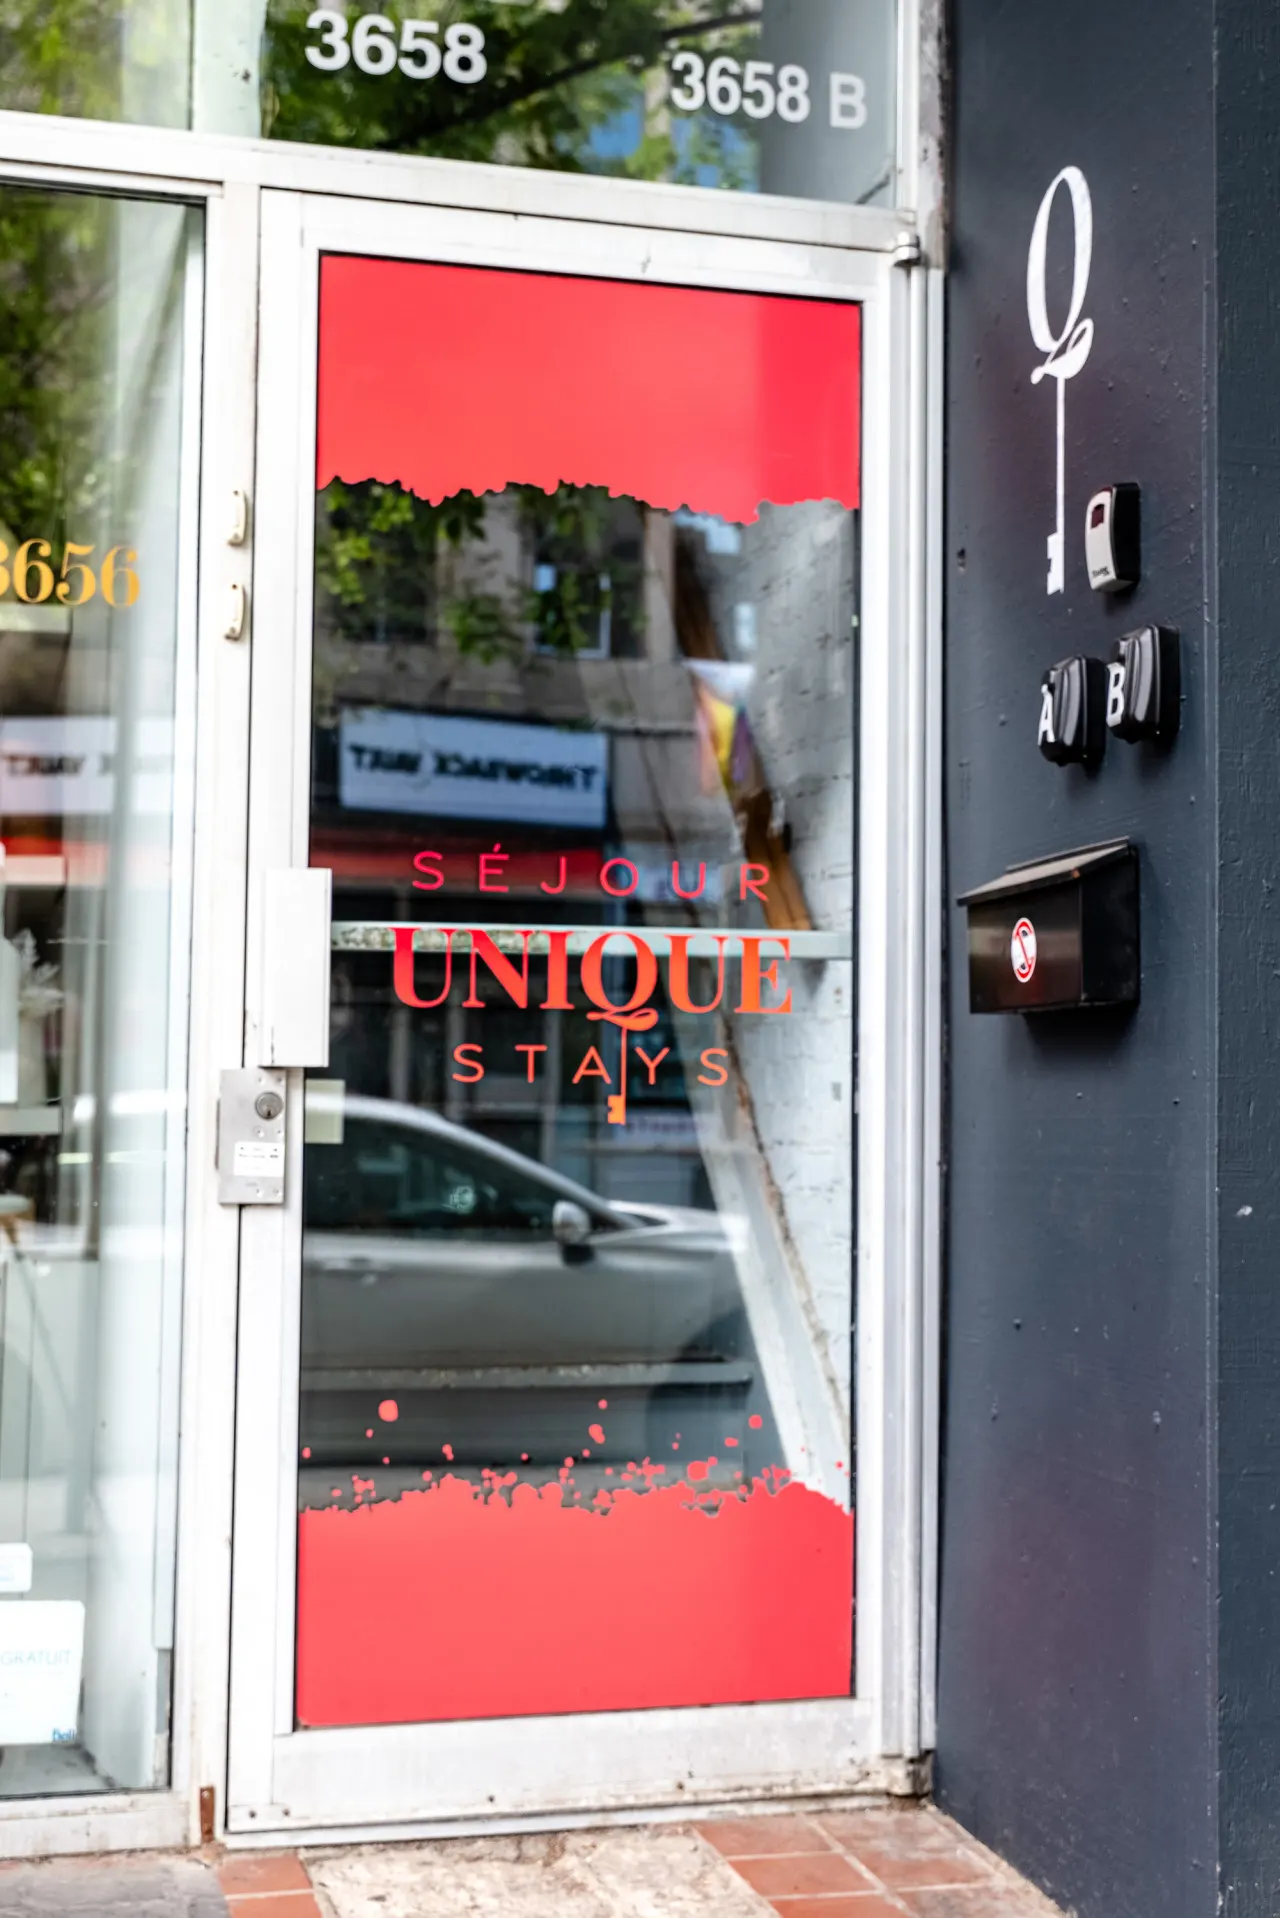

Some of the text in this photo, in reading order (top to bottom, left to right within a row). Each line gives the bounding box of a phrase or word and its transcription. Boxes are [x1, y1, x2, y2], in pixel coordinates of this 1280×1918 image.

[304, 10, 488, 84] 3658
[670, 52, 867, 129] 3658 B
[0, 538, 140, 608] 656
[1037, 683, 1056, 746] A
[1106, 661, 1126, 728] B
[411, 842, 771, 901] SÉJOUR
[388, 926, 793, 1032] UNIQUE
[451, 1043, 730, 1087] STAYS
